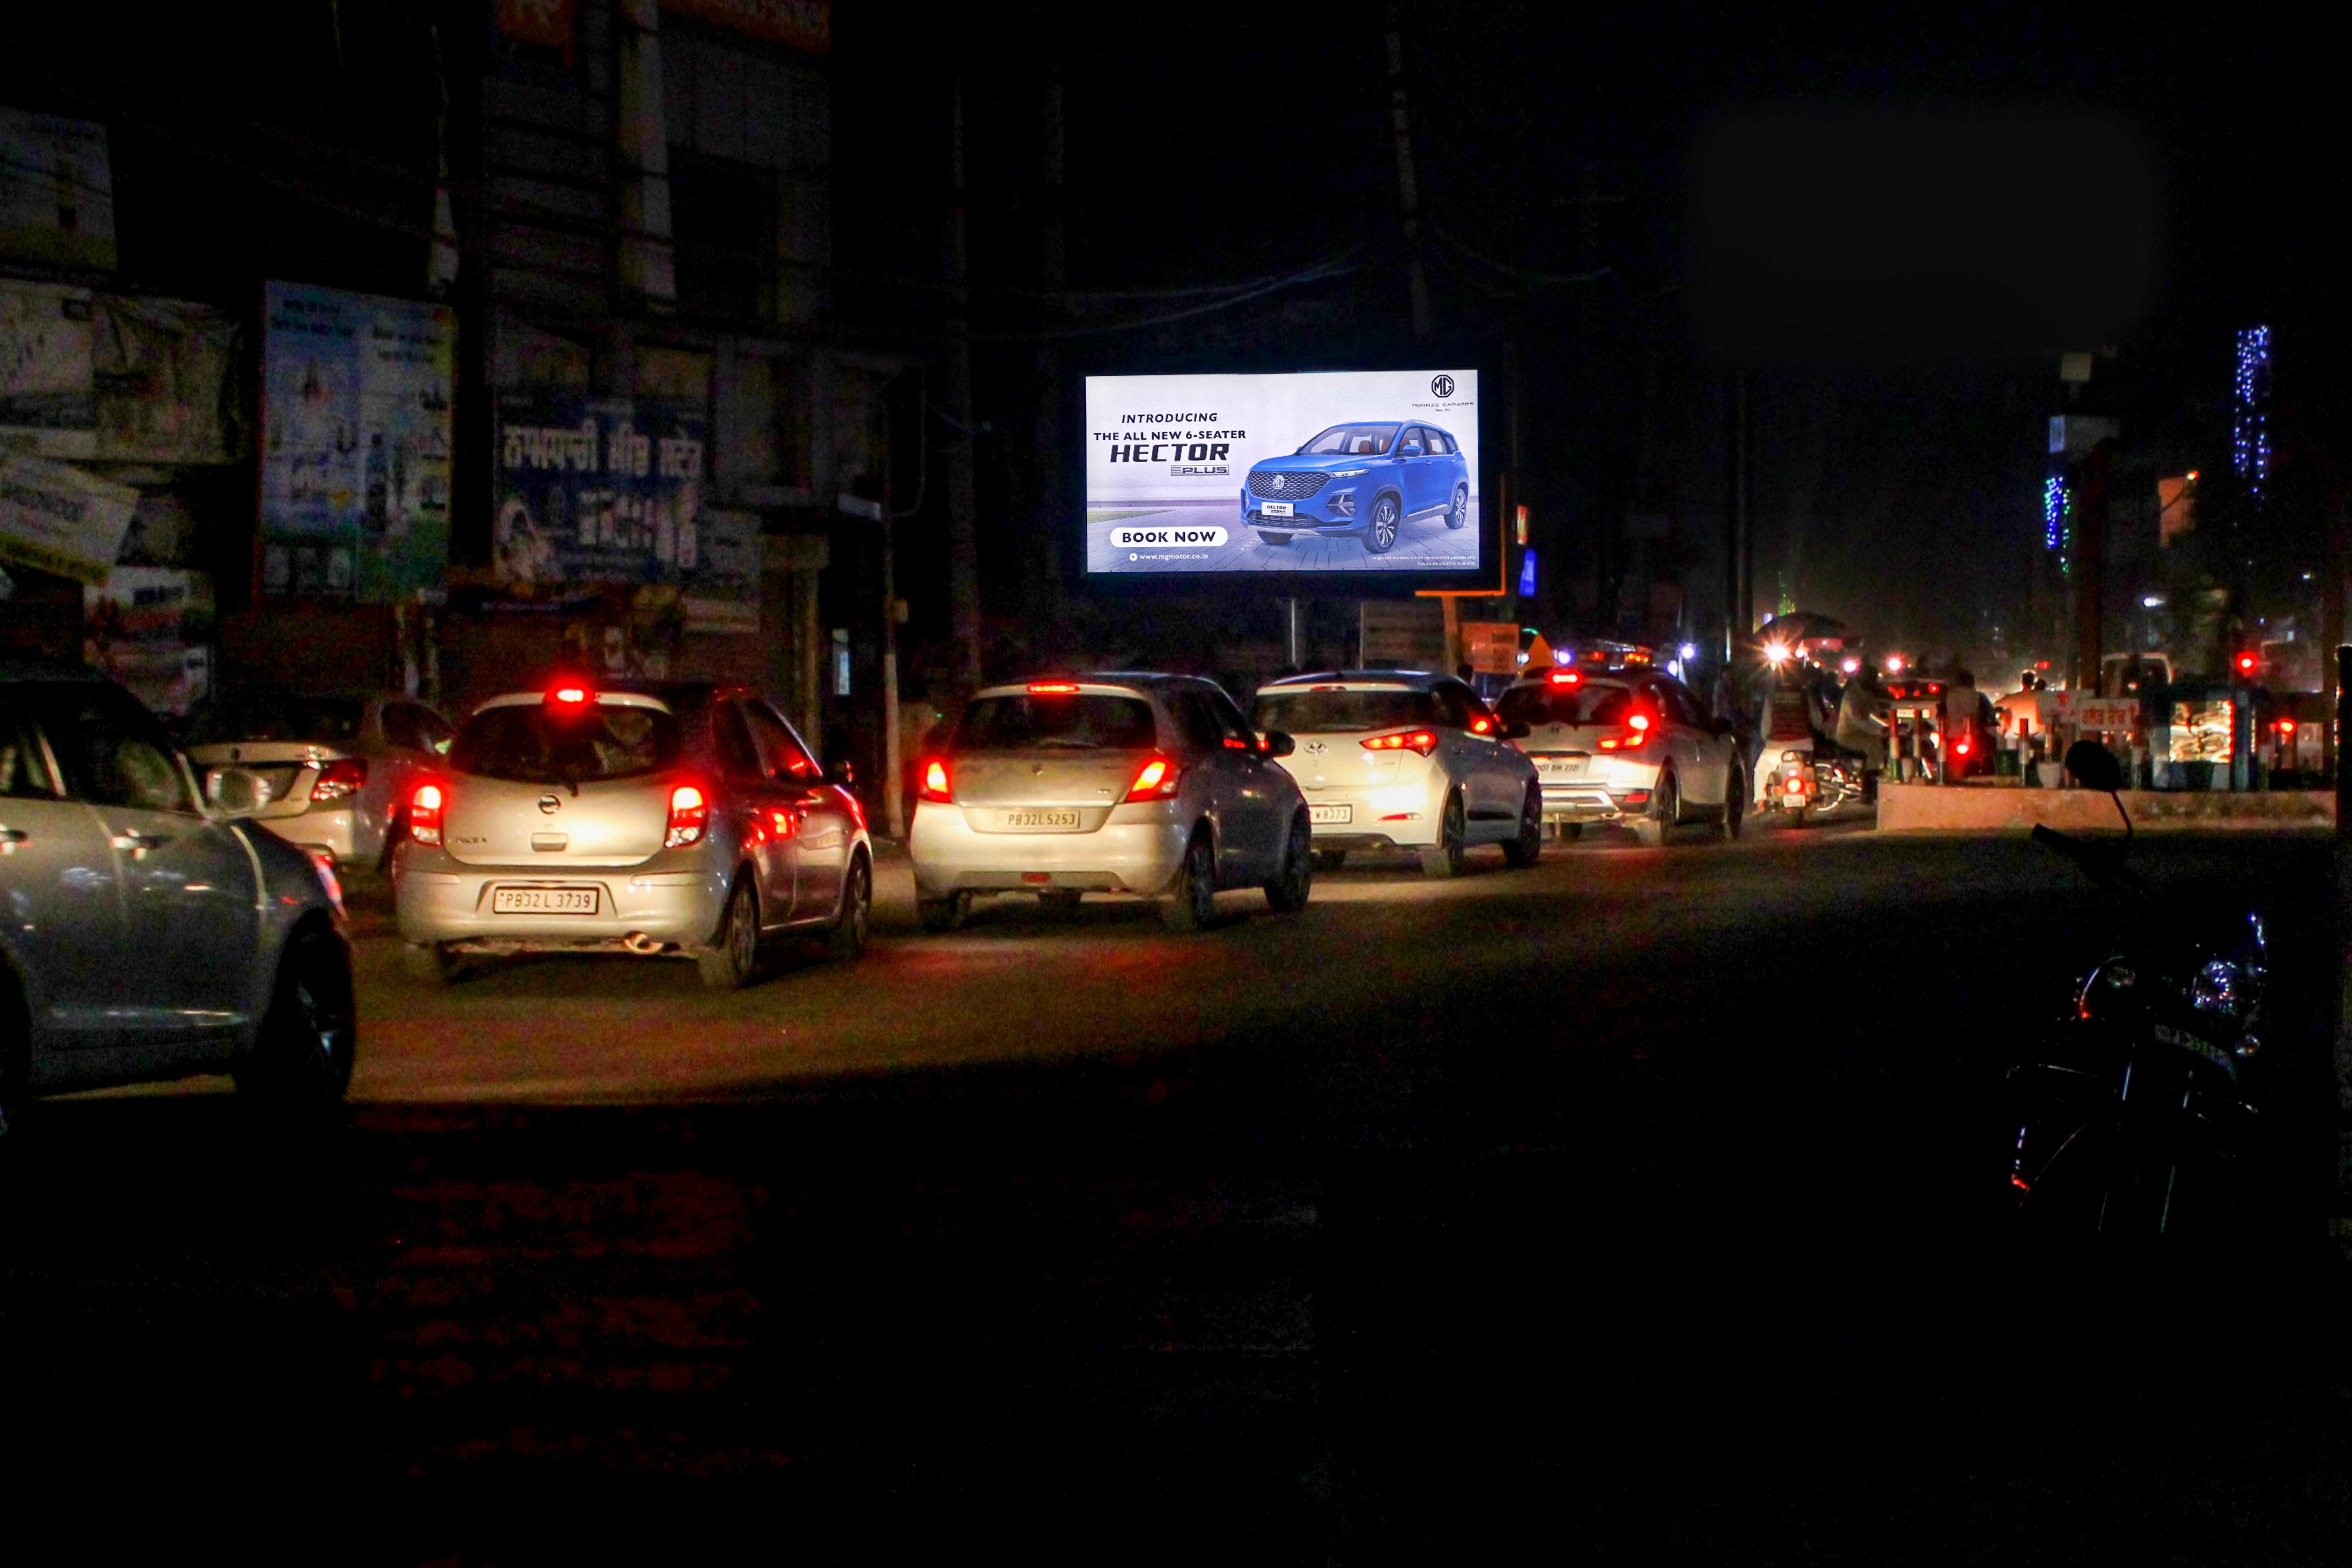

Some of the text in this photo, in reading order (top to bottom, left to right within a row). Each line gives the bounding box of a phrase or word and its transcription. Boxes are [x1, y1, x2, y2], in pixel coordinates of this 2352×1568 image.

[1434, 377, 1452, 396] MG
[1122, 413, 1218, 423] INTRODUCING
[1093, 430, 1246, 441] THE ALL NEW 6-SEATER
[1110, 443, 1229, 463] HECTOR
[1122, 531, 1216, 543] BOOK NOW
[1047, 813, 1075, 825] 5253
[506, 893, 540, 908] PB32
[556, 893, 590, 908] 3739
